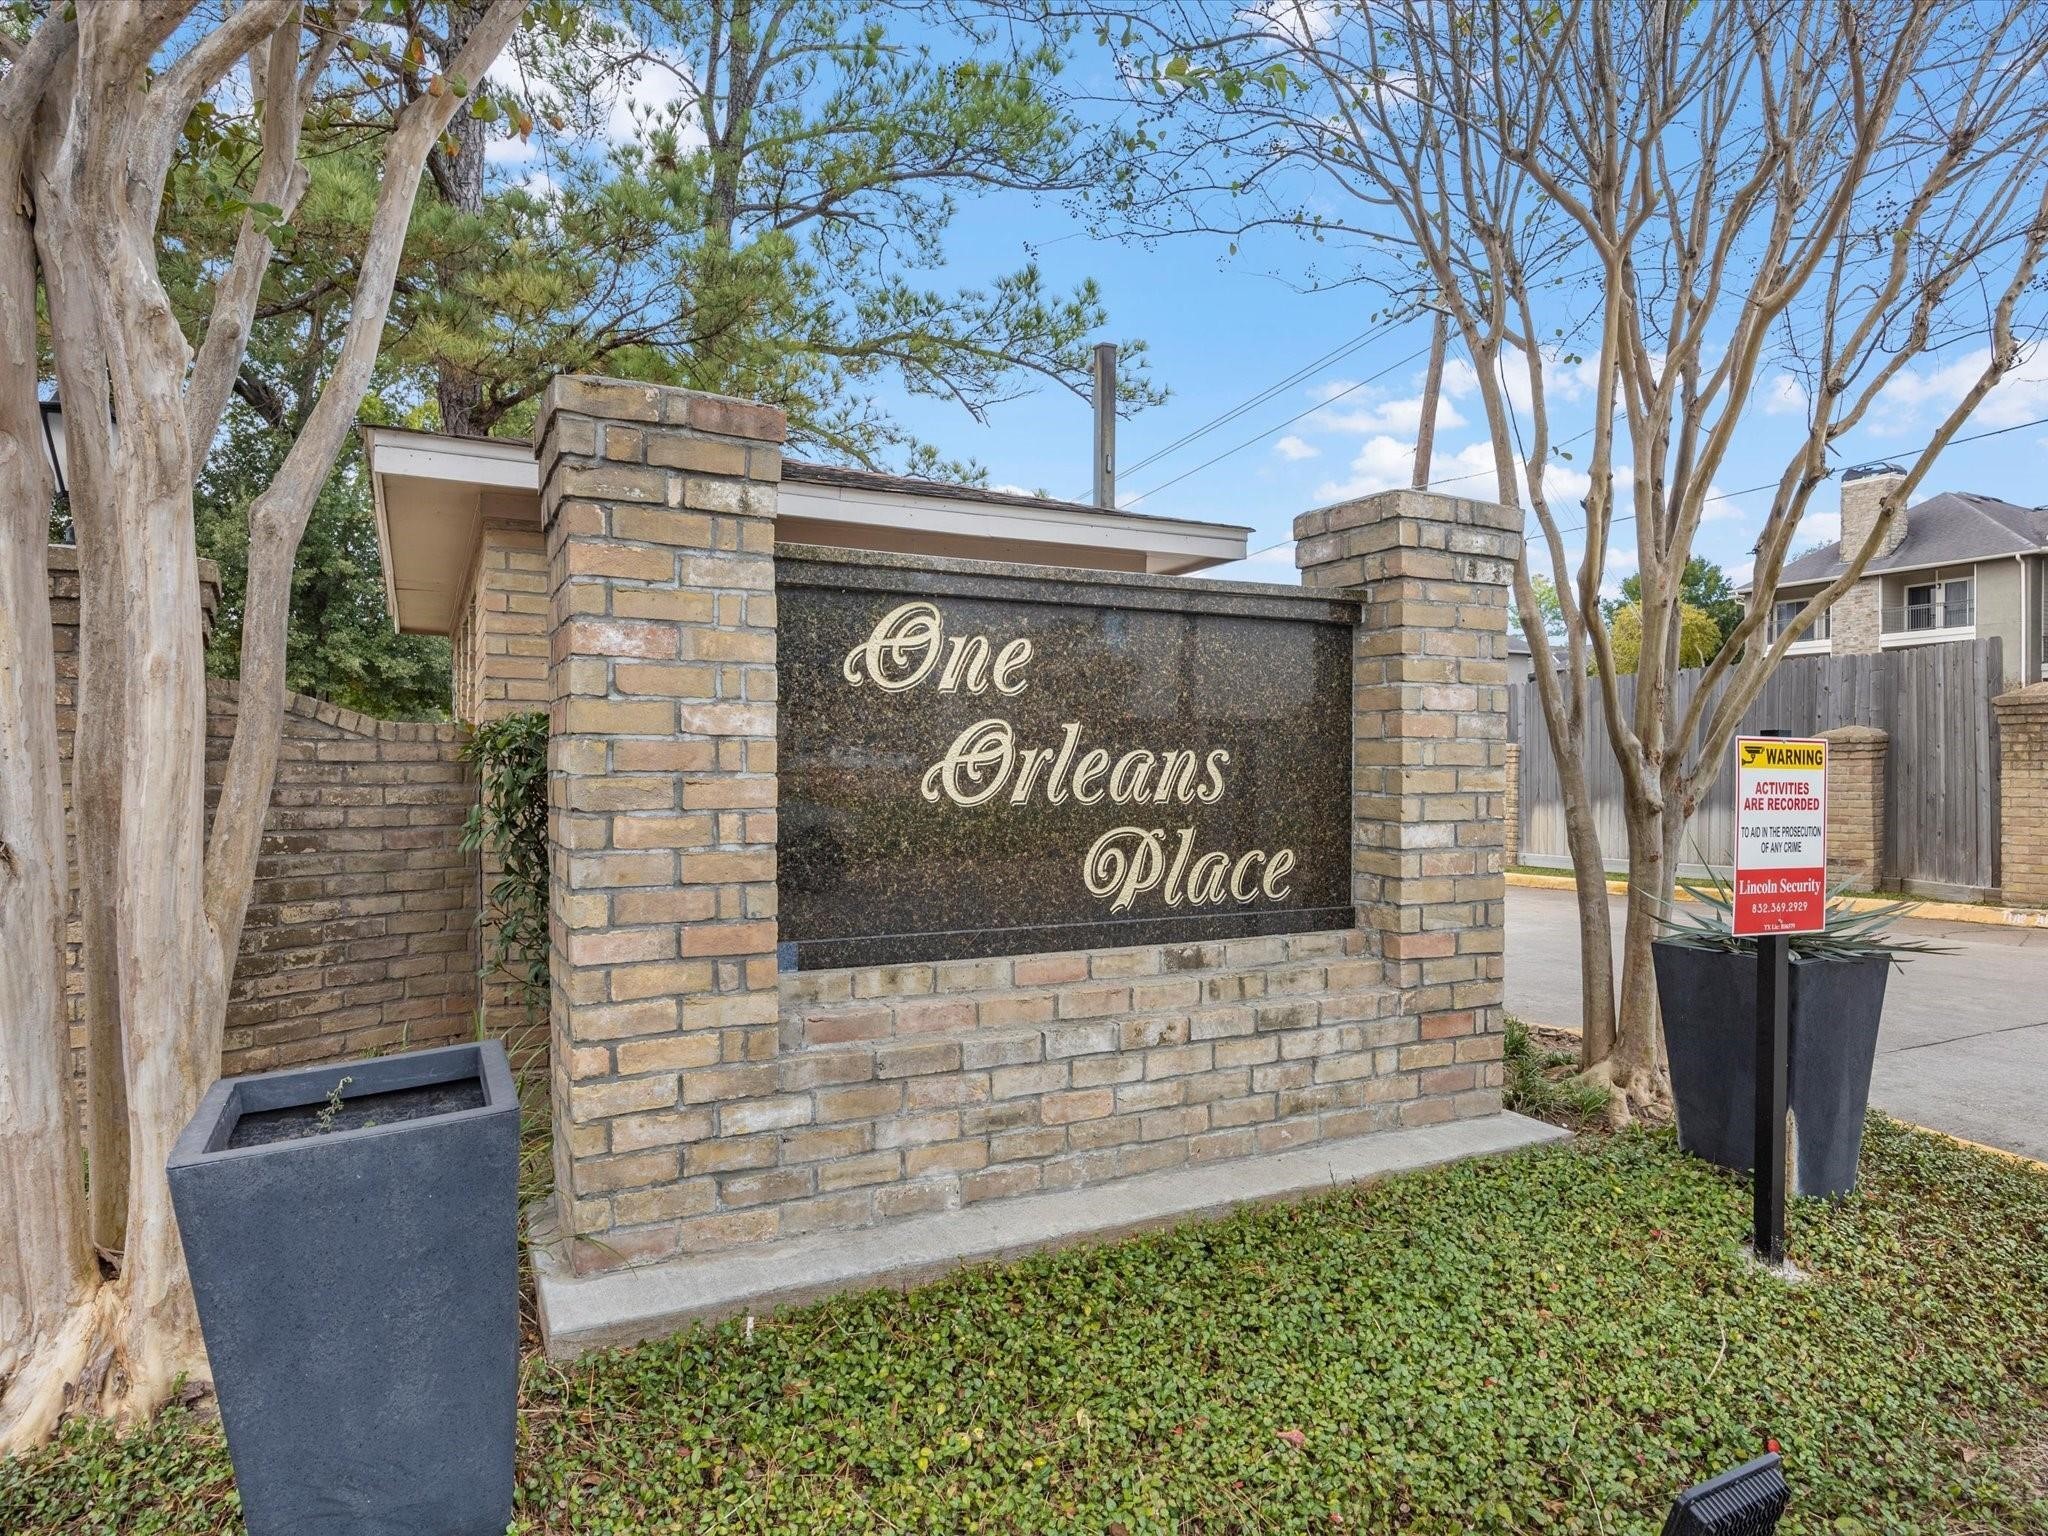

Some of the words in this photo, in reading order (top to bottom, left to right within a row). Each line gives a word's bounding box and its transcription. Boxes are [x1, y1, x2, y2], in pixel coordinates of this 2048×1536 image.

[842, 601, 1034, 697] One
[921, 718, 1231, 807] Orleans
[1766, 748, 1823, 765] WARNING
[1755, 782, 1809, 795] ACTIVITIES
[1744, 798, 1764, 811] ARE
[1768, 798, 1820, 811] RECORDED
[1741, 827, 1749, 838] TO
[1751, 827, 1760, 837] AID
[1762, 827, 1768, 838] IN
[1769, 827, 1780, 838] THE
[1782, 826, 1822, 838] PROSECUTION
[1761, 842, 1769, 853] OF
[1771, 842, 1782, 853] ANY
[1784, 842, 1802, 852] CRIME
[1083, 826, 1297, 915] Place
[1739, 879, 1778, 895] Lincoln
[1780, 878, 1821, 895] Security
[1752, 902, 1808, 914] 832.369.2929
